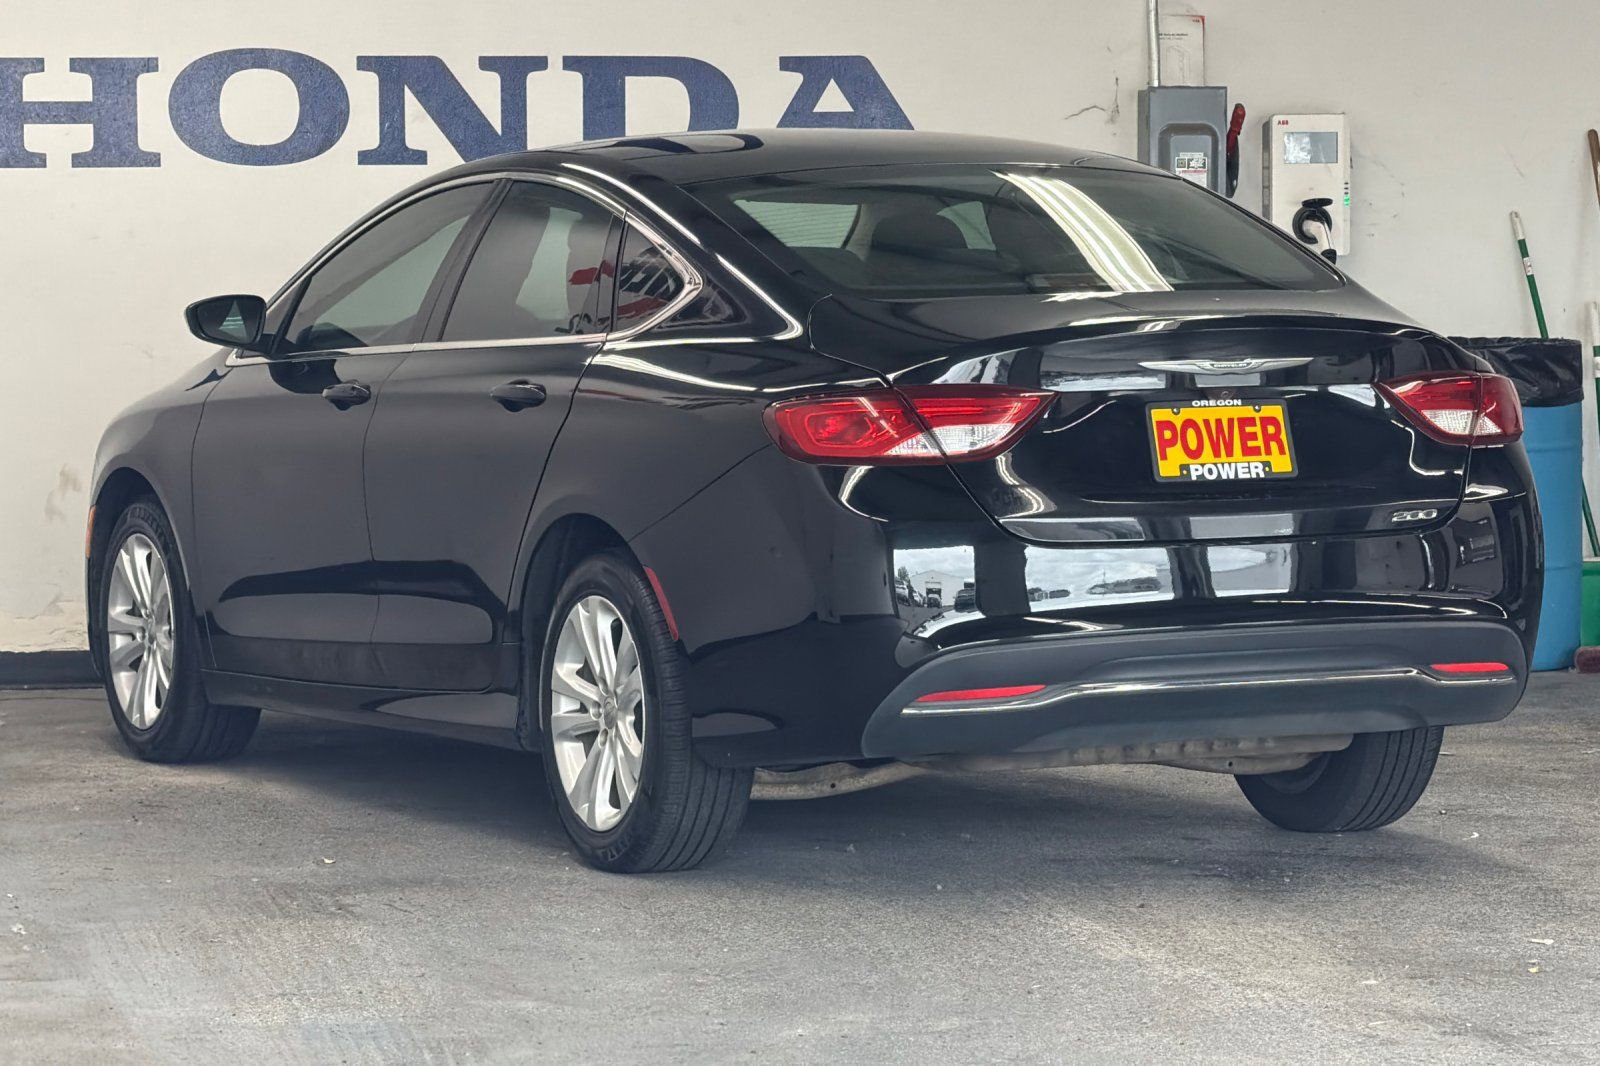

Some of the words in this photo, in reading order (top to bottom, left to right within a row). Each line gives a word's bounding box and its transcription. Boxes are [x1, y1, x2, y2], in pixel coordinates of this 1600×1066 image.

[0, 48, 914, 169] HONDA
[1191, 399, 1242, 407] OREGON
[1155, 416, 1286, 461] POWER
[1189, 462, 1265, 481] POWER
[1392, 509, 1438, 522] 200
